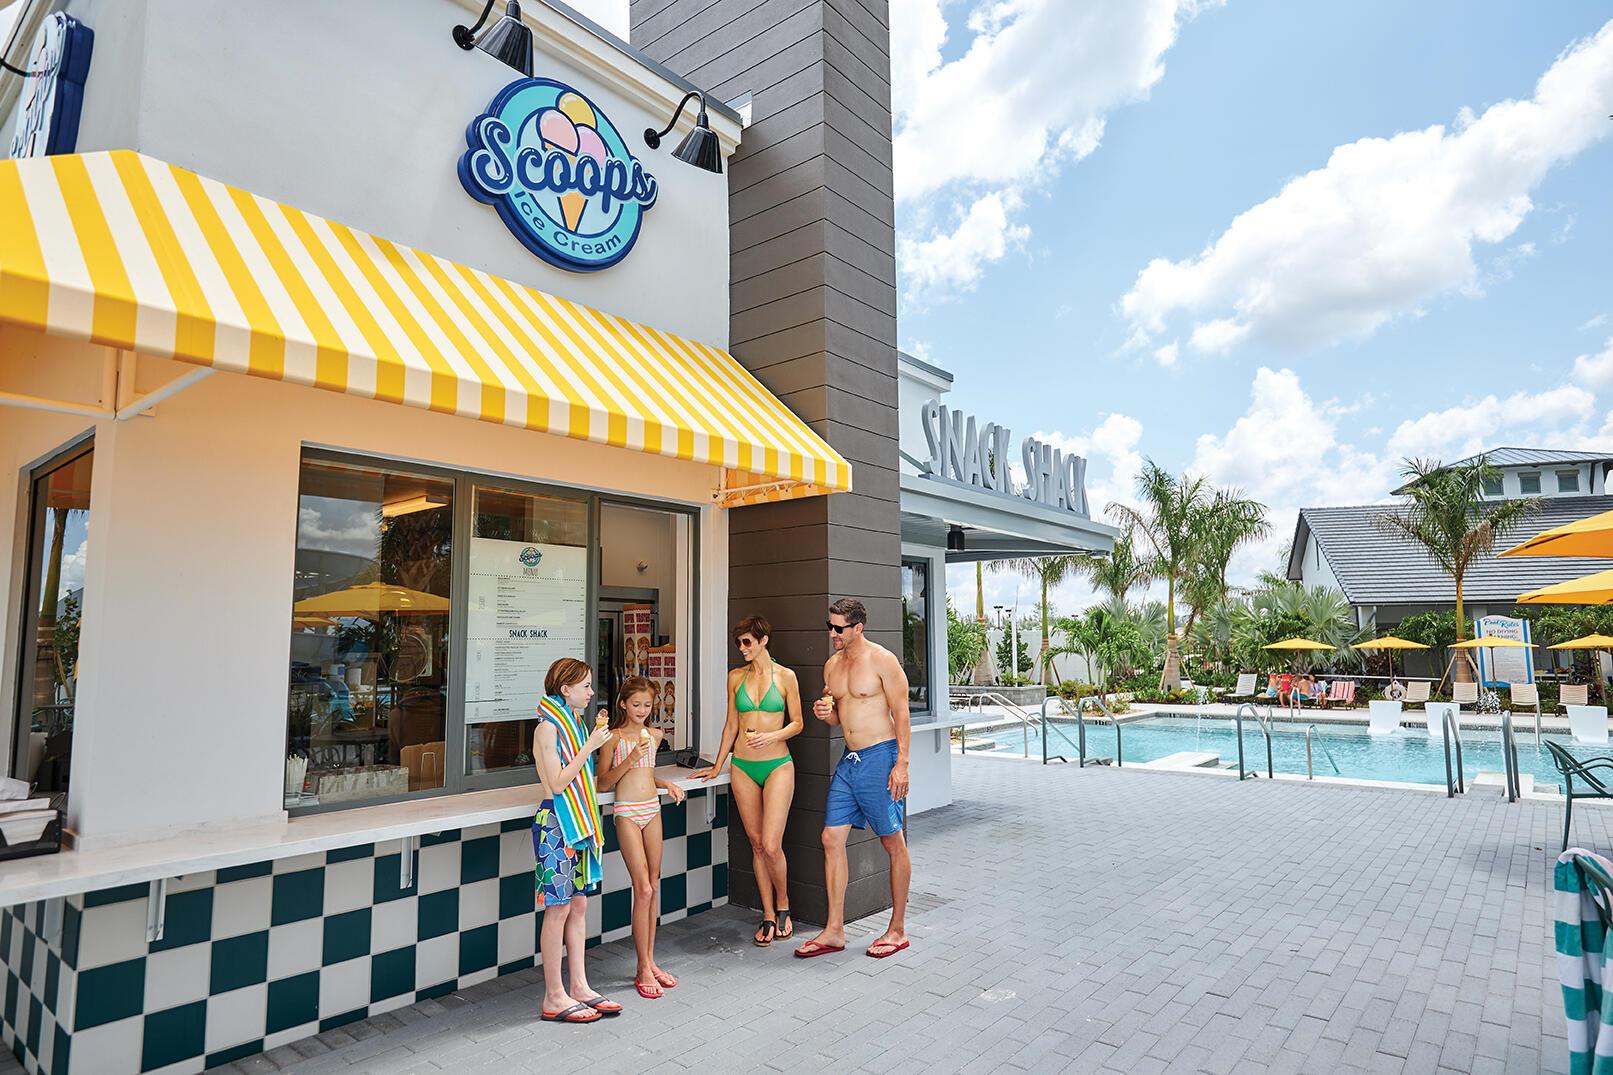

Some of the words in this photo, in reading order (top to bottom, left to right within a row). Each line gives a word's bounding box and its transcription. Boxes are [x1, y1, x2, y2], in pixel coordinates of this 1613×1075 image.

[475, 120, 657, 214] Scoops
[514, 190, 545, 231] Ice
[553, 231, 622, 255] Cream
[922, 399, 1015, 496] SNACK
[1022, 437, 1091, 521] SHACK
[509, 629, 528, 638] SNACK
[529, 629, 548, 638] SHACK
